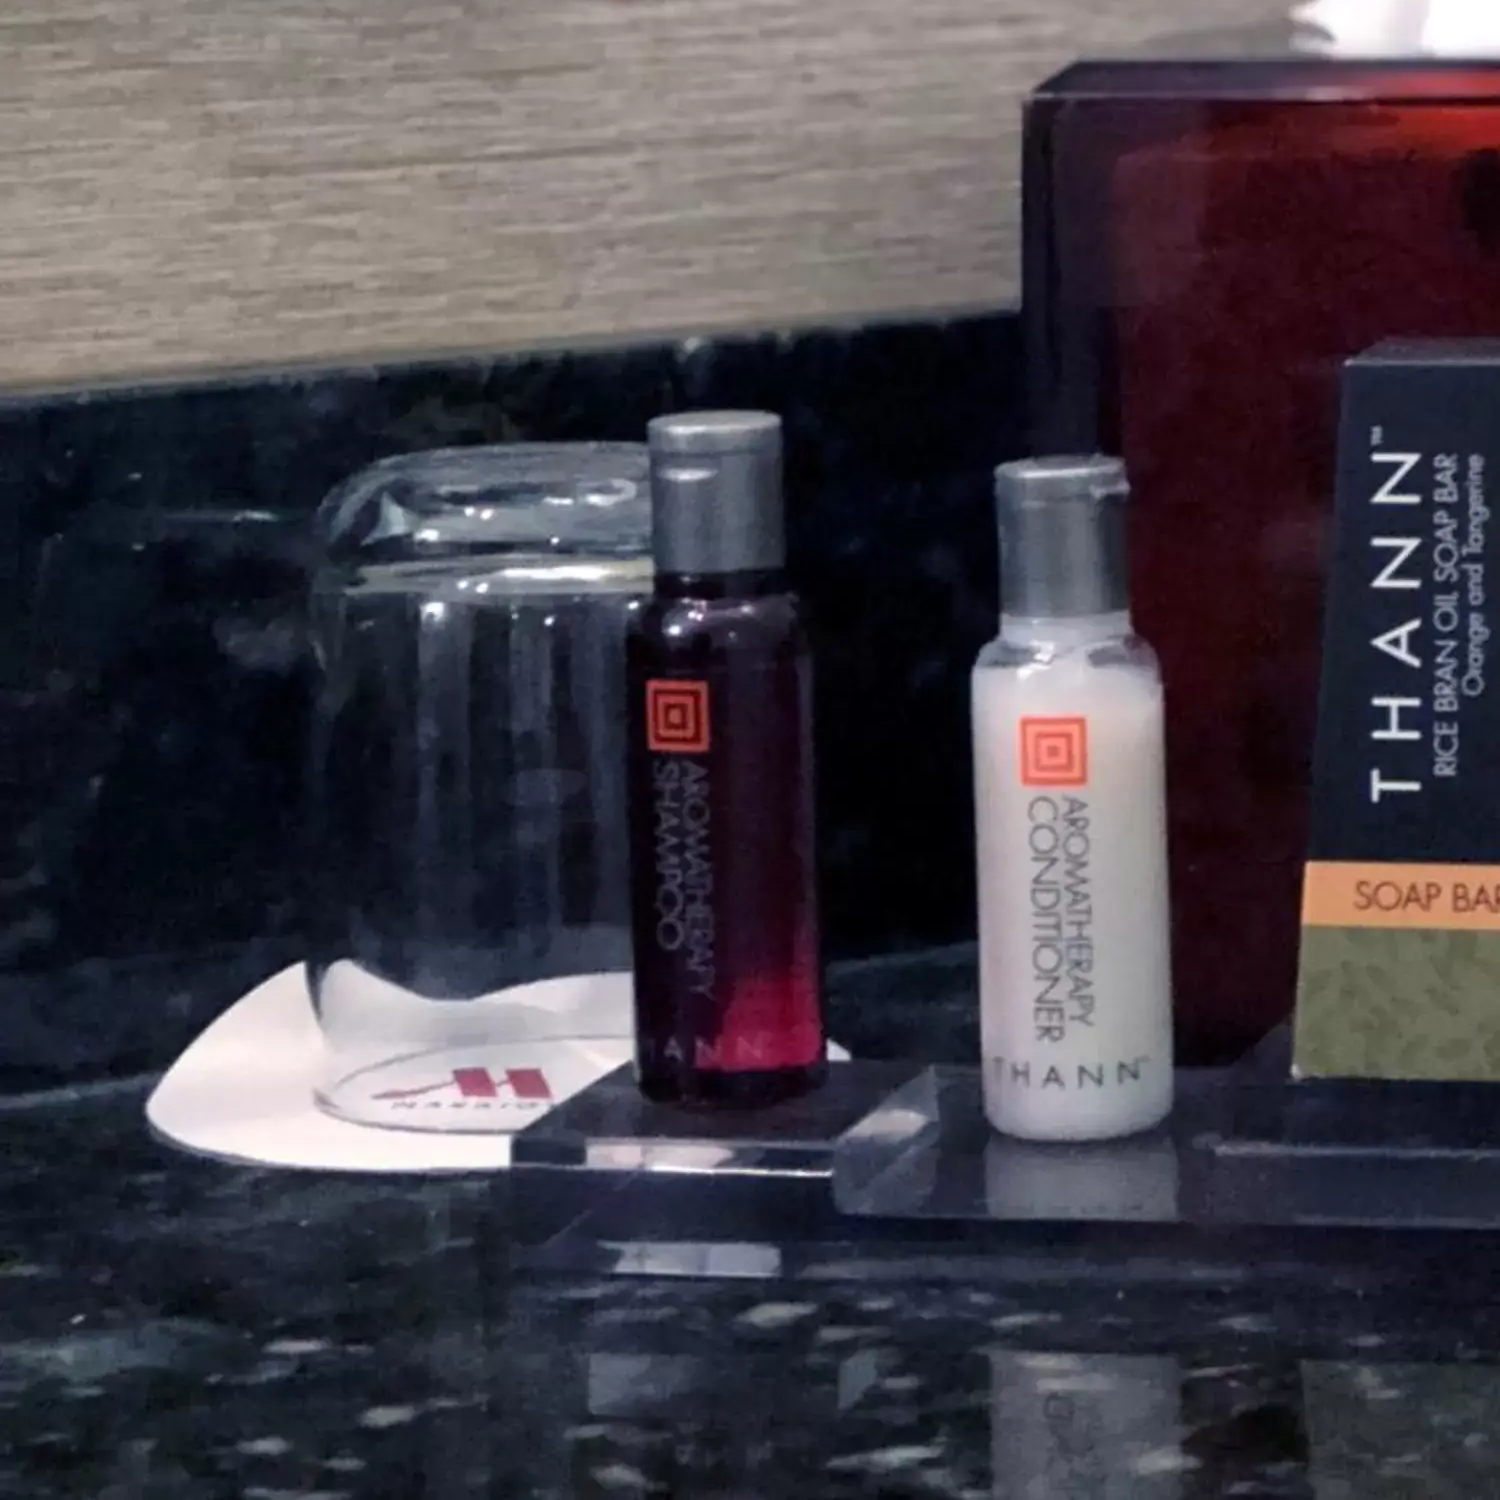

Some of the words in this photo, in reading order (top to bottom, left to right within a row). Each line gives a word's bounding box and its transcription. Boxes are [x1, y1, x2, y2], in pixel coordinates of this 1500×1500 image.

[1433, 453, 1459, 503] BAR
[1462, 453, 1491, 556] Tangerine
[1433, 510, 1459, 582] SOAP
[1433, 591, 1459, 633] OIL
[1460, 563, 1485, 606] and
[1370, 453, 1422, 803] THANN
[1462, 612, 1491, 696] Orange
[1433, 639, 1459, 712] BRAN
[1433, 721, 1459, 777] RICE
[653, 760, 684, 952] SHAMPOO
[1028, 795, 1064, 1044] CONDITIONER
[1062, 794, 1095, 1028] AROMATHERAPY
[1354, 880, 1442, 912] SOAP
